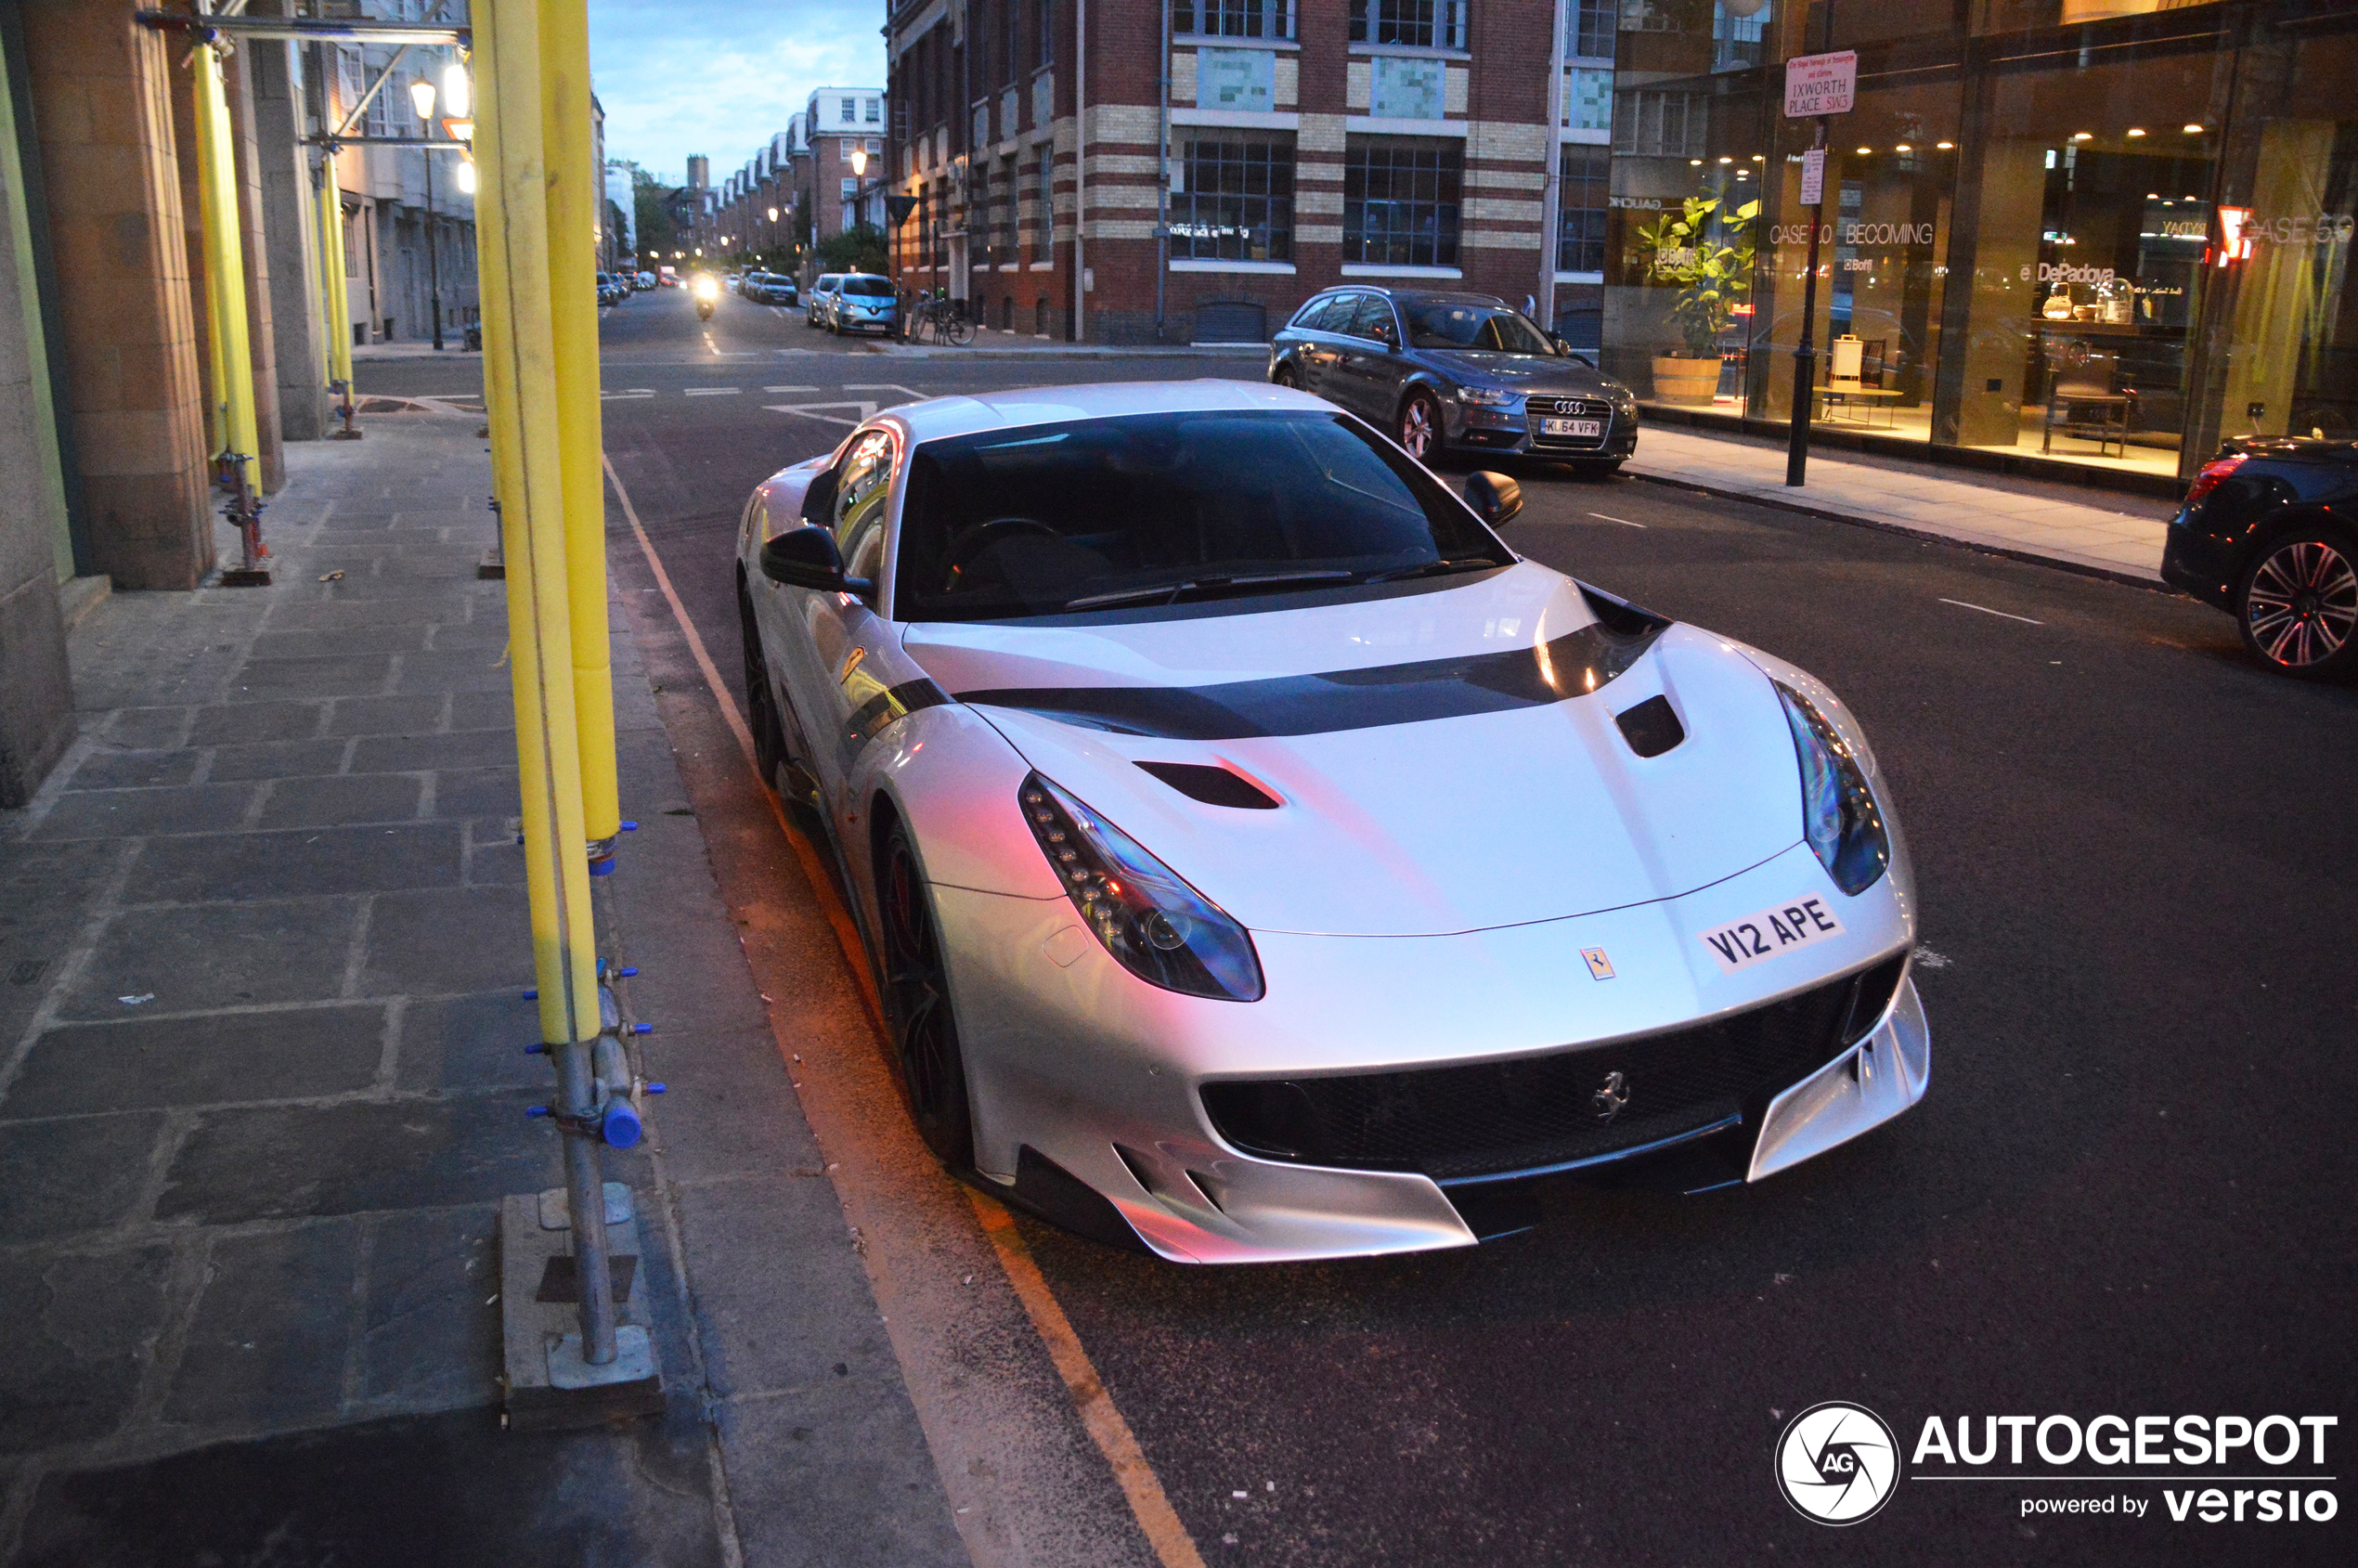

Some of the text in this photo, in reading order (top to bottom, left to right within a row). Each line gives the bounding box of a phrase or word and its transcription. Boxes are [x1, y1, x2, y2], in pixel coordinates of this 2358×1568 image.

[1793, 79, 1846, 97] IXWORTH
[1769, 224, 1808, 244] CASE
[1846, 223, 1933, 245] BECOMING
[2037, 262, 2115, 283] DePadova
[1547, 421, 1598, 434] KU64 VFK
[1706, 899, 1835, 964] V12 APE
